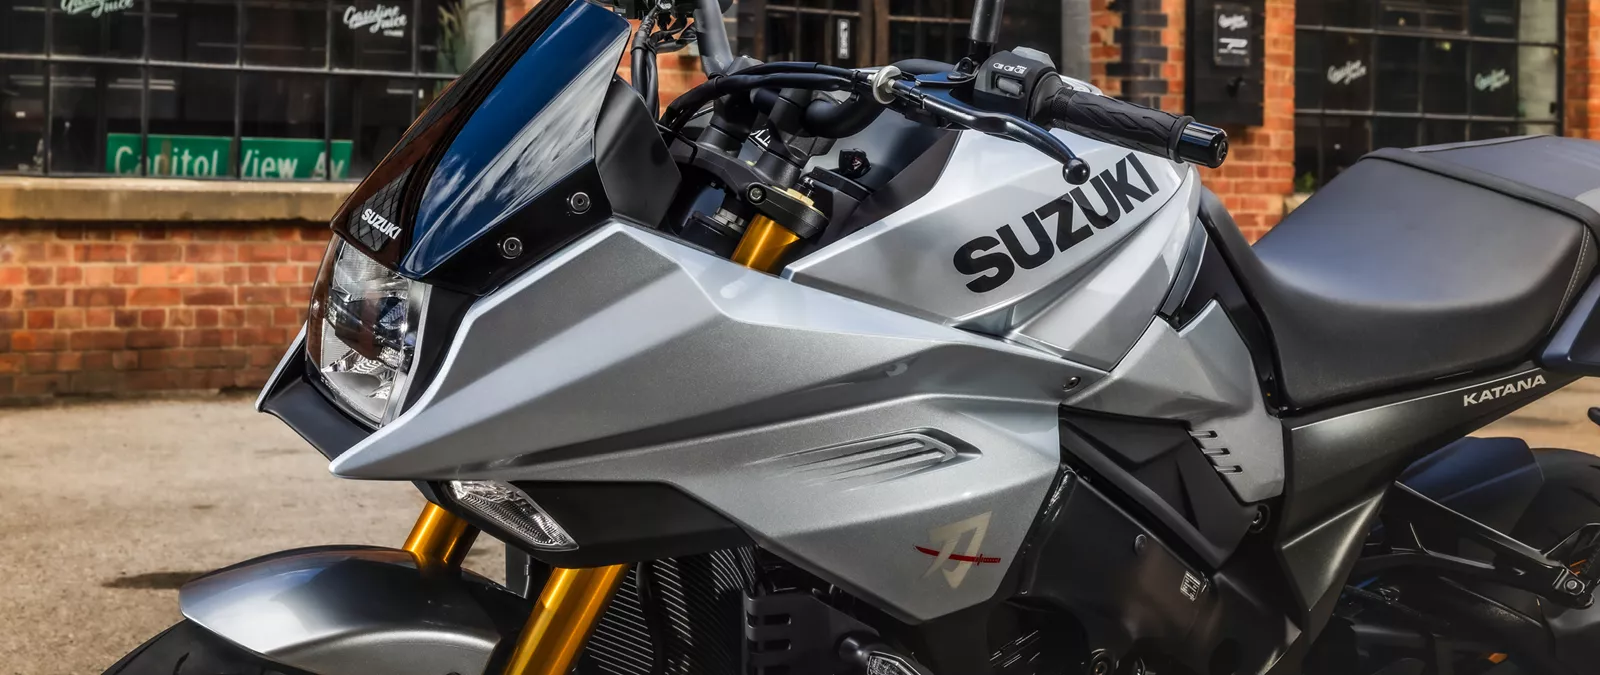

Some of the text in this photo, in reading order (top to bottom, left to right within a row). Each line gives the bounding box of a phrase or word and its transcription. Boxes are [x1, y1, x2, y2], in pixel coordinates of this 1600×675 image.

[361, 208, 402, 240] SUZUKI
[953, 152, 1160, 293] SUZUKI
[1463, 374, 1546, 407] KATANA
